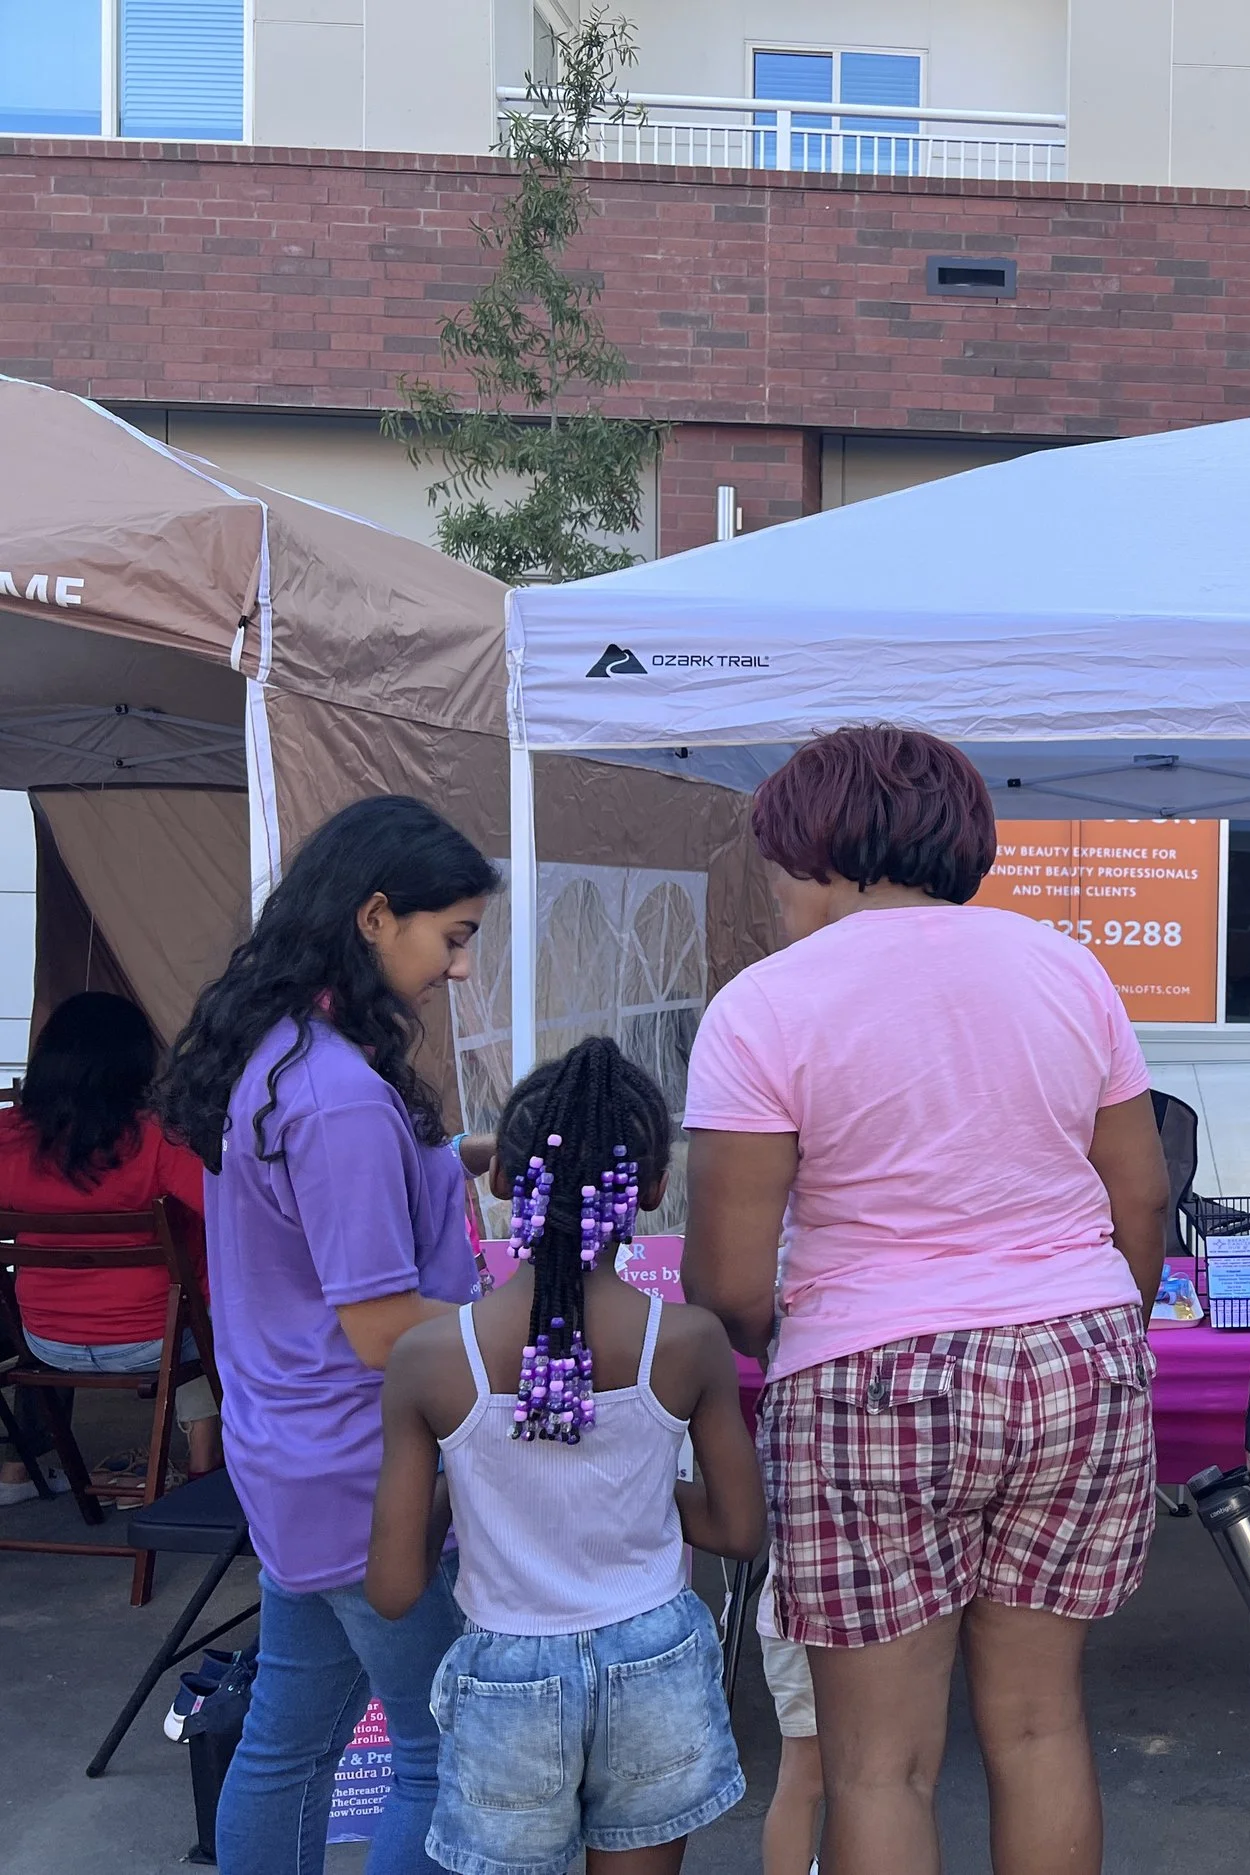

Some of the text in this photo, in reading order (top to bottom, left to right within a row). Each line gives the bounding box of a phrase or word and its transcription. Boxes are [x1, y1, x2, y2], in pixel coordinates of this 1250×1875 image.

[652, 655, 770, 667] OZARK TRAIL
[996, 845, 1177, 860] EW BEAUTY EXPERIENCE FOR
[990, 865, 1199, 880] ENDENT BEAUTY PROFESSIONALS
[1012, 885, 1137, 898] AND THEIR CLIENTS
[621, 1266, 680, 1283] ives by
[351, 1735, 390, 1745] arolina
[367, 1751, 392, 1765] Pre
[334, 1768, 377, 1781] mudra
